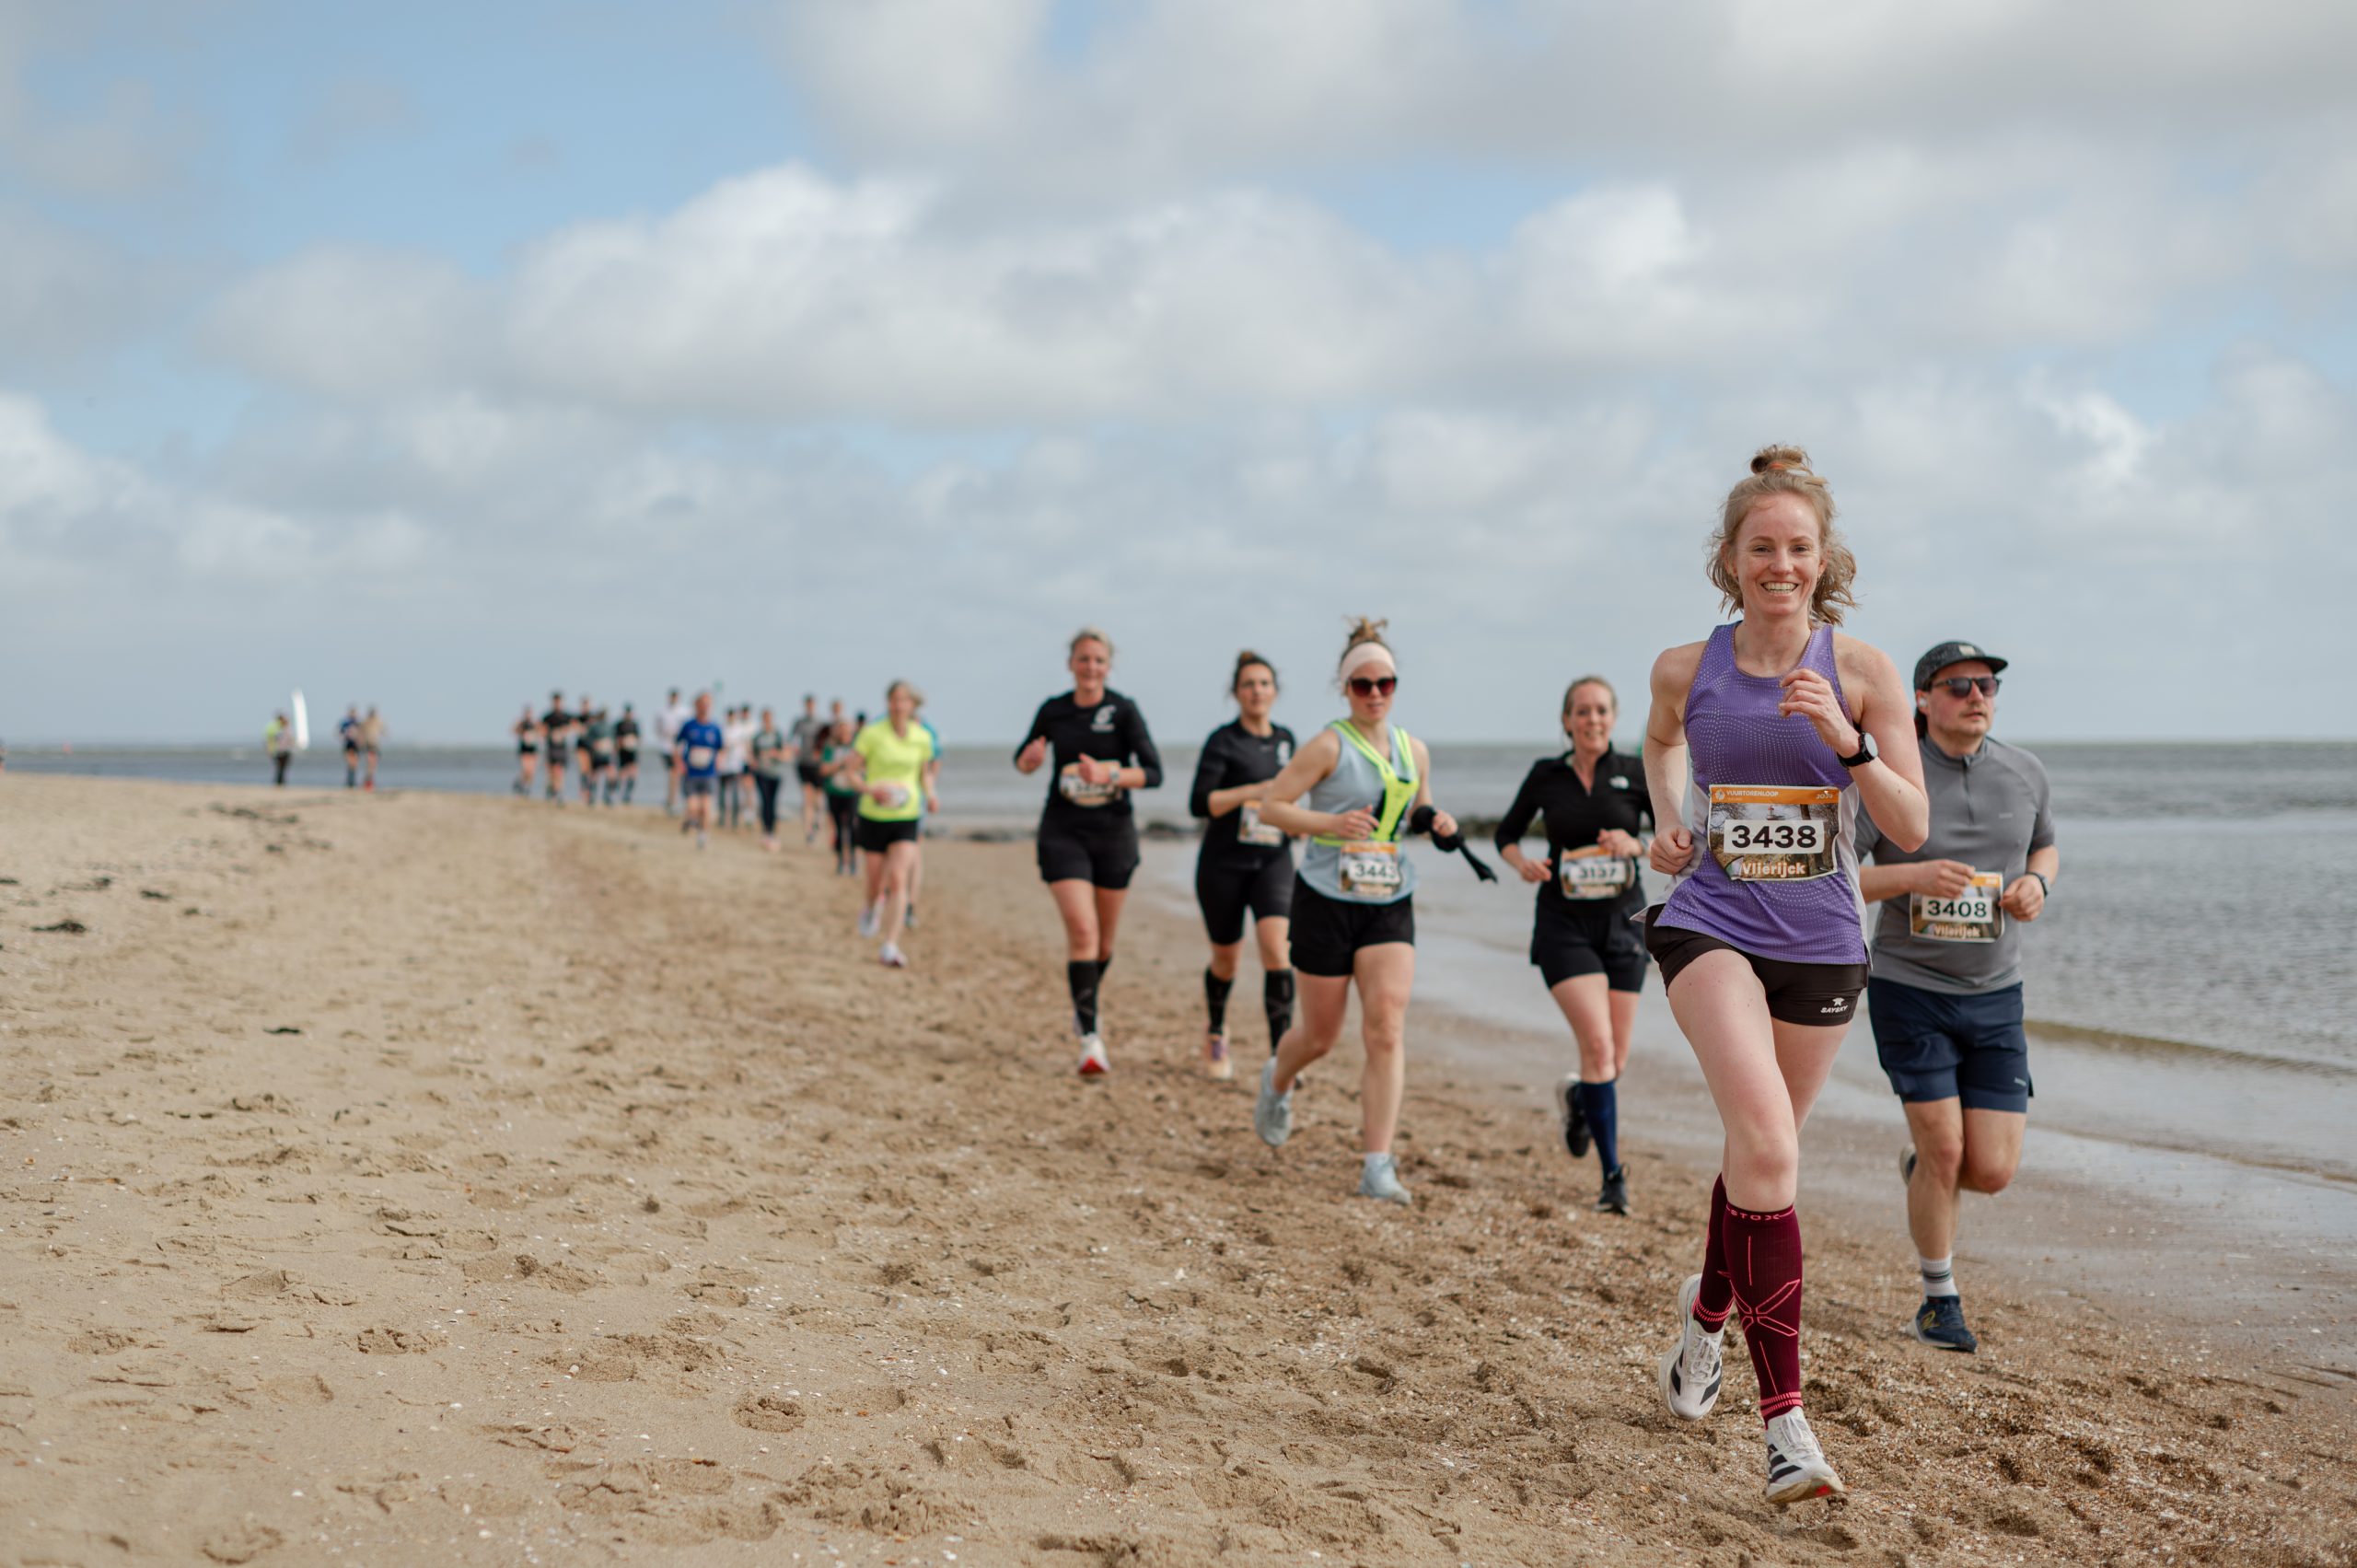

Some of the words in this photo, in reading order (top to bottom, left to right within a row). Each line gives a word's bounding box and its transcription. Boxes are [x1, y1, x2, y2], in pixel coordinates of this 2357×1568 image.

[1731, 825, 1817, 848] 3438
[1741, 862, 1806, 877] Vlierijck
[1927, 900, 1987, 918] 3408
[1820, 1005, 1849, 1014] SAYSKY
[1730, 1209, 1781, 1221] STOX
